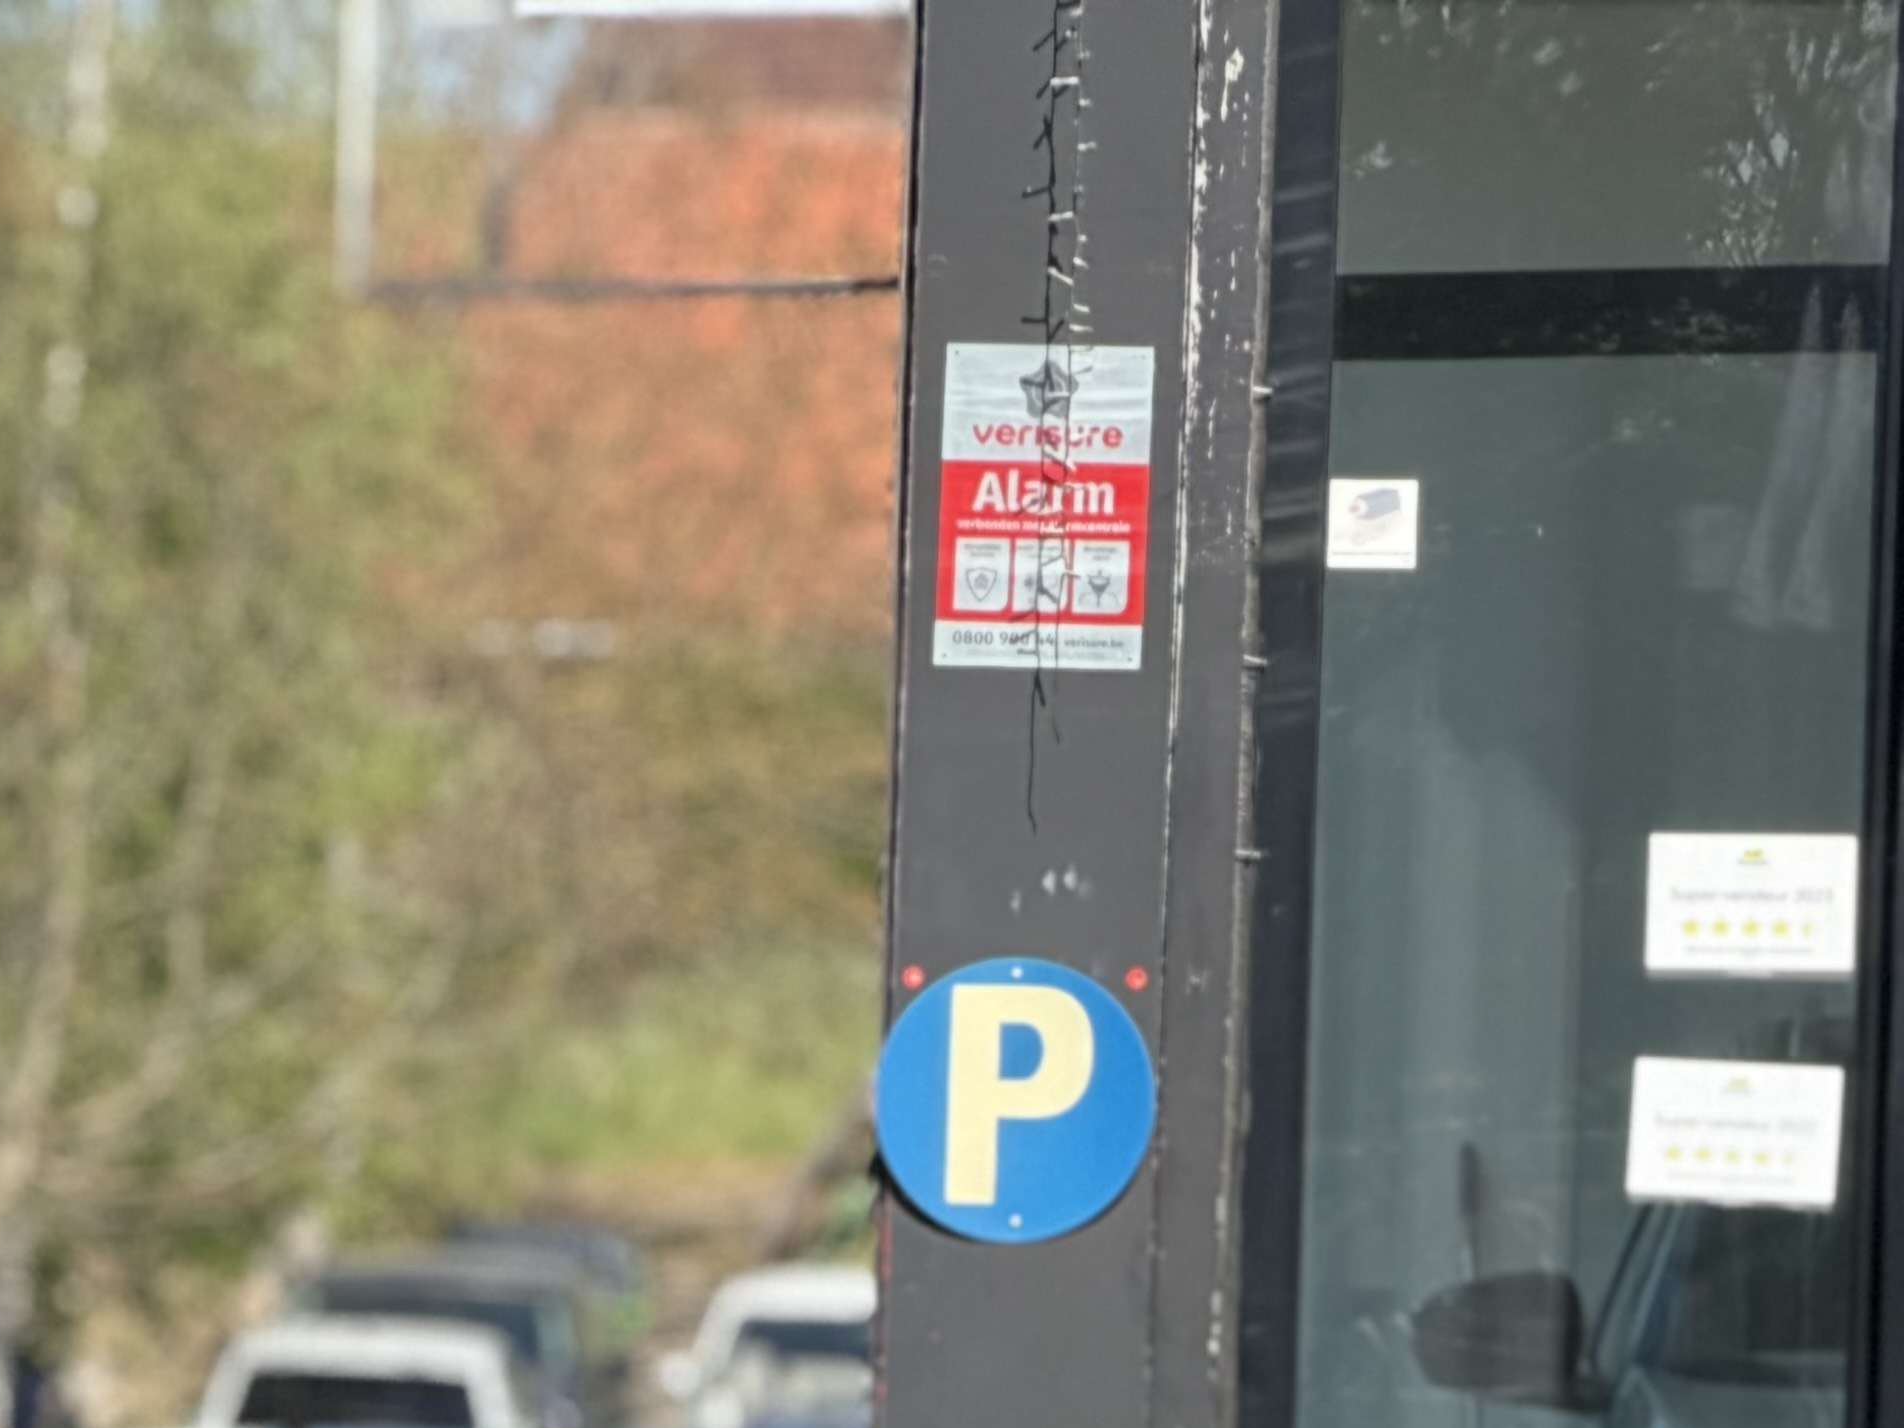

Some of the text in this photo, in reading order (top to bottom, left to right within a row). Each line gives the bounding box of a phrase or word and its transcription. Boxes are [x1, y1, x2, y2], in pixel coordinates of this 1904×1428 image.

[971, 468, 1115, 516] Alarm
[952, 630, 994, 646] 0800
[946, 982, 1096, 1205] P
